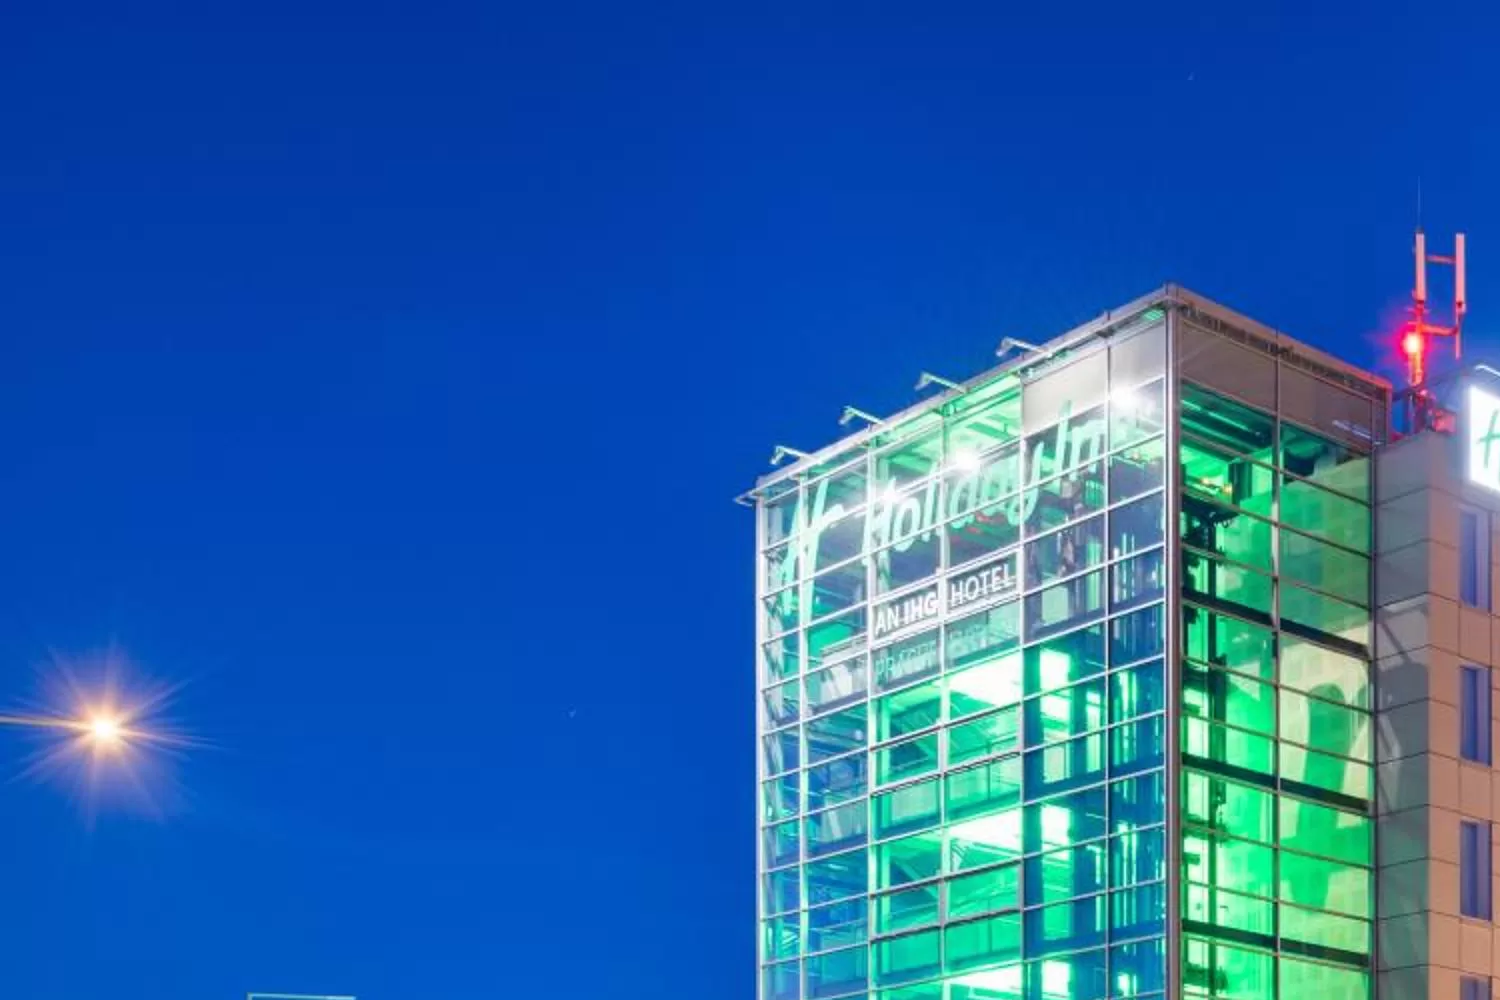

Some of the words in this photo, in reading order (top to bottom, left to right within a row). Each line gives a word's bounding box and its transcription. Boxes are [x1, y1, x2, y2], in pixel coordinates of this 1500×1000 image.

[874, 603, 900, 636] AN
[903, 590, 938, 625] IHG
[951, 563, 1016, 608] HOTEL
